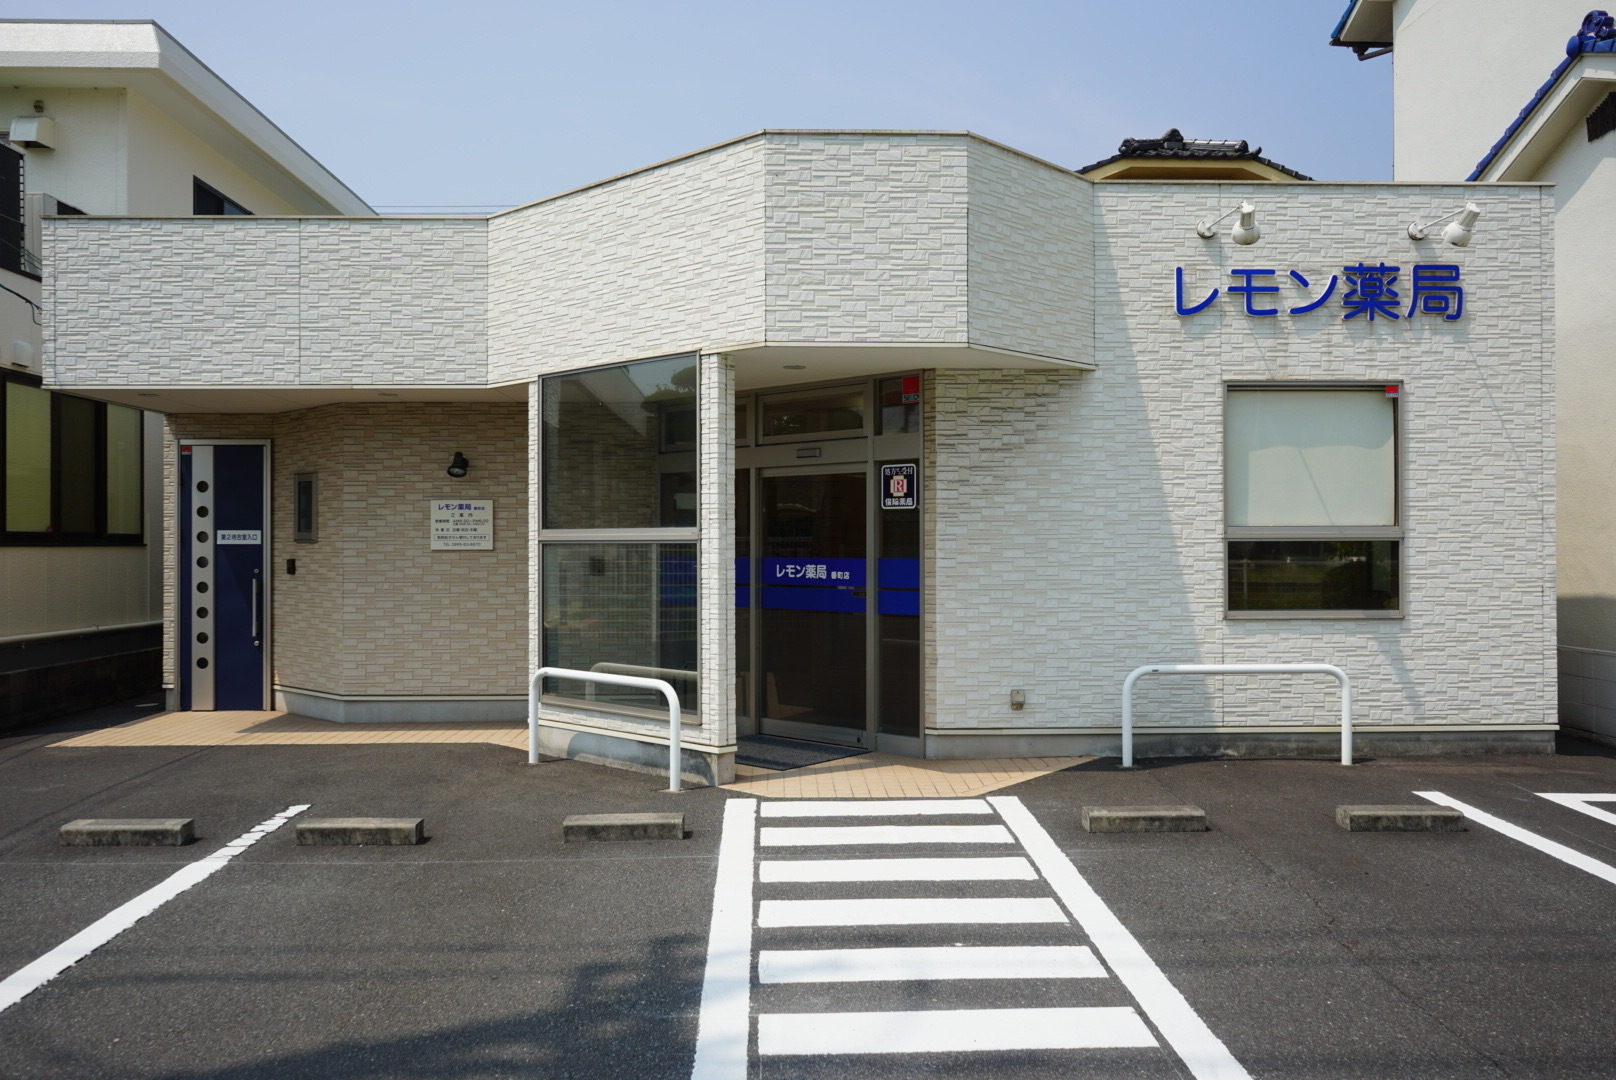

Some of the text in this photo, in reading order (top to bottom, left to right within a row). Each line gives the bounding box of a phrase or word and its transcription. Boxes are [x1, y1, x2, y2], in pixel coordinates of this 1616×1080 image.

[1174, 262, 1463, 321] レモン薬局
[885, 497, 913, 506] 保険薬局
[776, 564, 850, 579] レモン薬局 番町店
